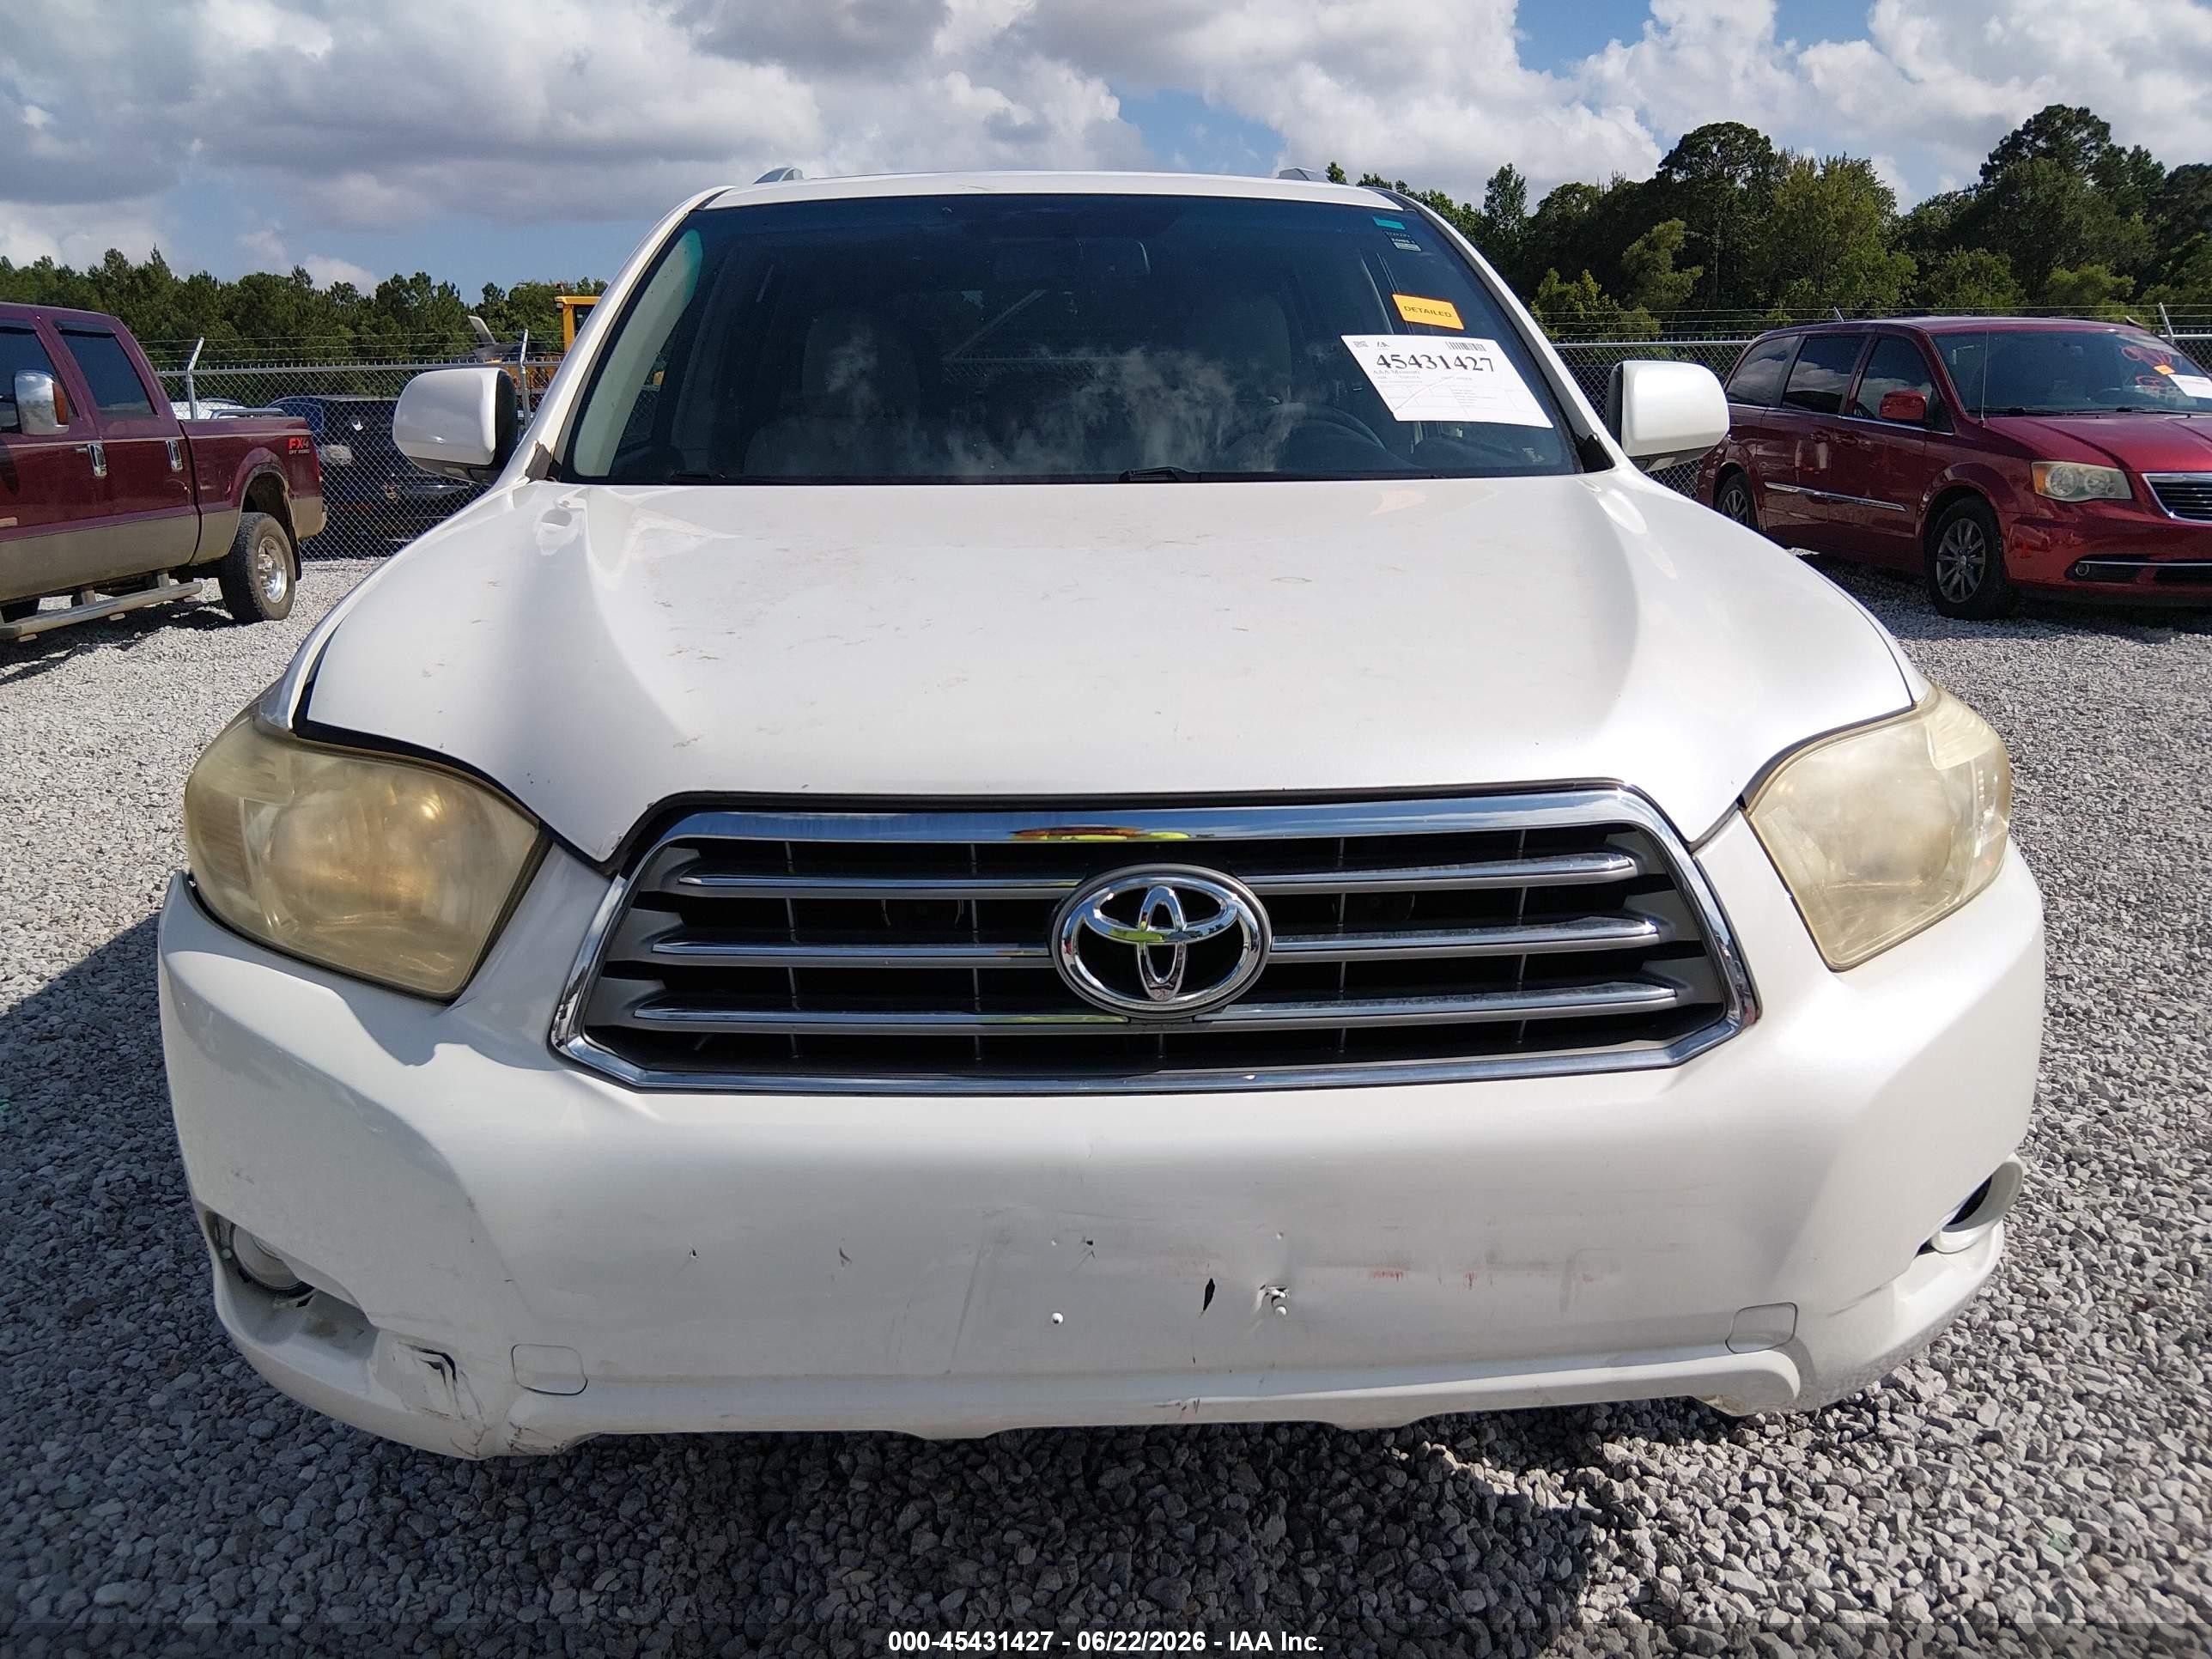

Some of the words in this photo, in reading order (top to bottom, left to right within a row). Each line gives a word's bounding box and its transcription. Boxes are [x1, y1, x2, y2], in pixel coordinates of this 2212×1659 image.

[1403, 306, 1452, 318] DETAILED
[1376, 354, 1494, 372] 45431427
[289, 438, 309, 449] FX4
